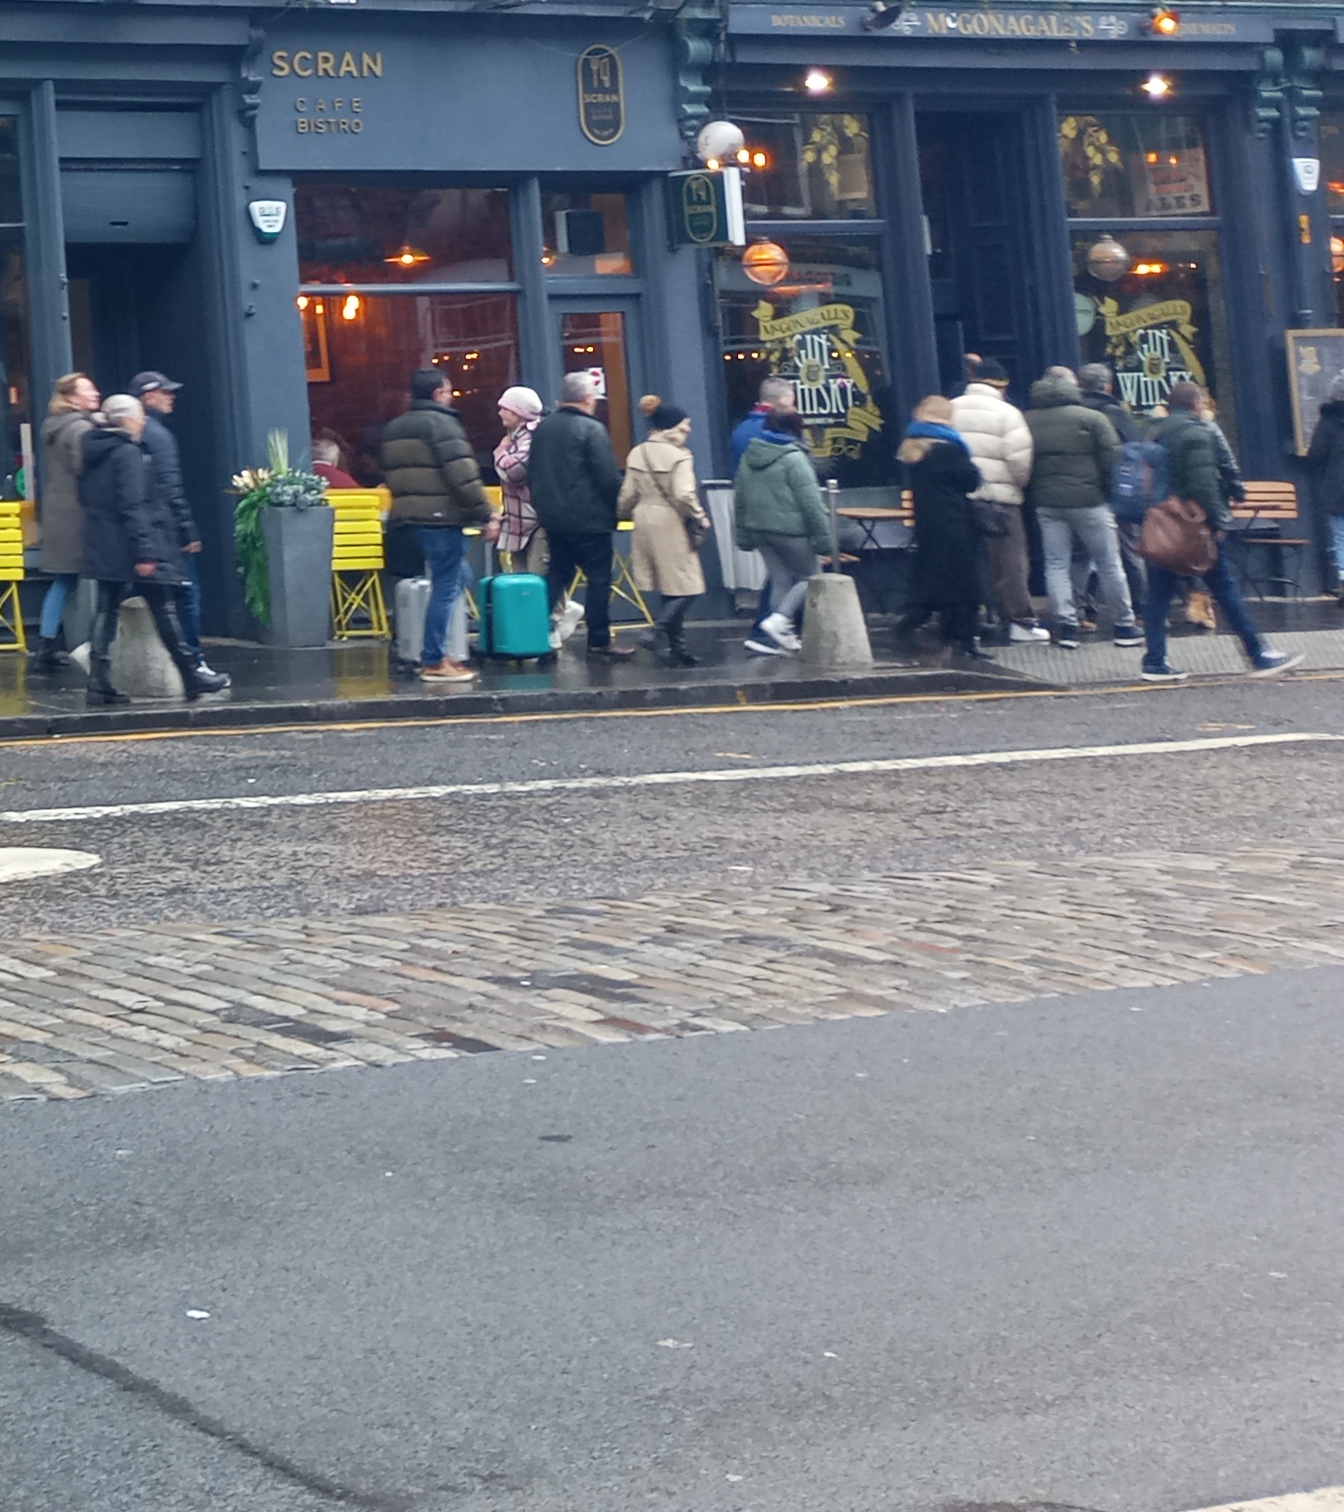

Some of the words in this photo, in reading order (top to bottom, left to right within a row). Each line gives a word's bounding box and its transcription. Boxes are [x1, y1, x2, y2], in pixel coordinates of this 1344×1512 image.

[271, 50, 384, 78] SCRAN
[295, 97, 363, 113] CAFE
[296, 117, 364, 133] BISTRO
